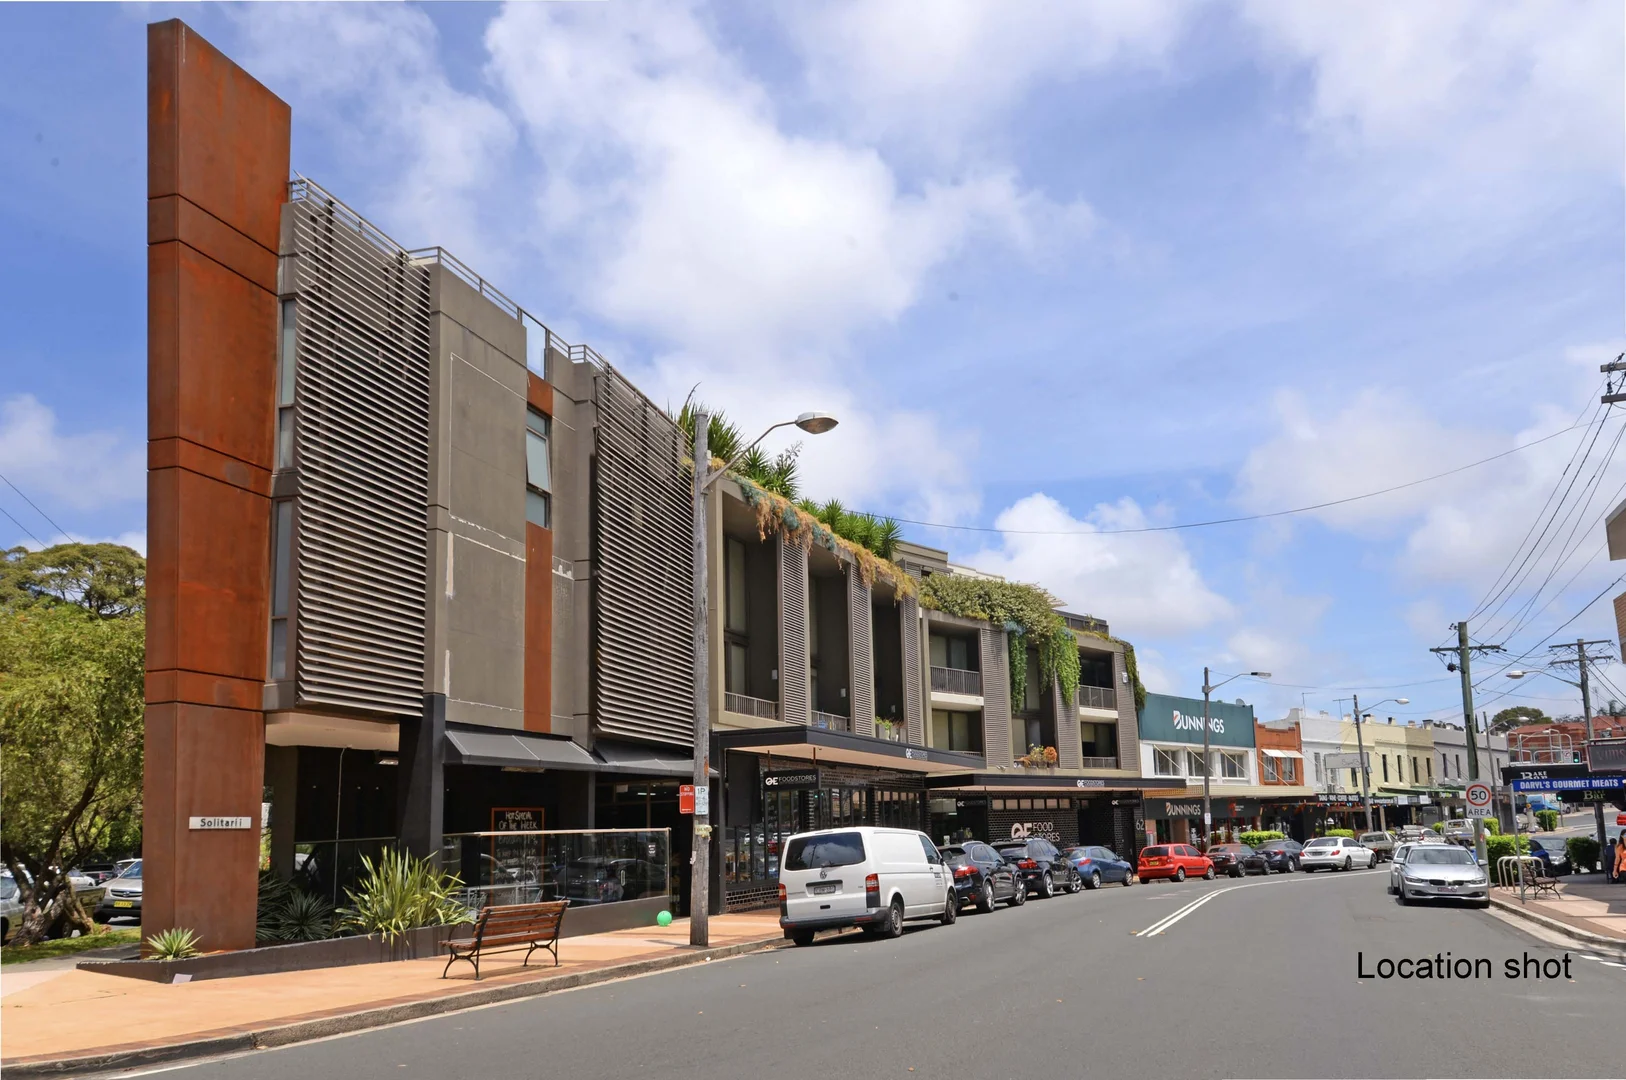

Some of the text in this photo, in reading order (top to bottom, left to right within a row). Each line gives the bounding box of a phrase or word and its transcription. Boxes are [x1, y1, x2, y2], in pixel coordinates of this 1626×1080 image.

[1173, 710, 1225, 734] BUNNINGS
[779, 774, 816, 782] FOODSTORES
[1520, 779, 1619, 789] DARYL'S GOURMET MEATS
[1470, 790, 1487, 801] 50
[1165, 802, 1201, 817] BUNNINGS
[1467, 808, 1492, 816] AREA
[200, 818, 243, 827] Solitarii
[1033, 822, 1053, 832] FOOD
[1136, 819, 1145, 831] 62
